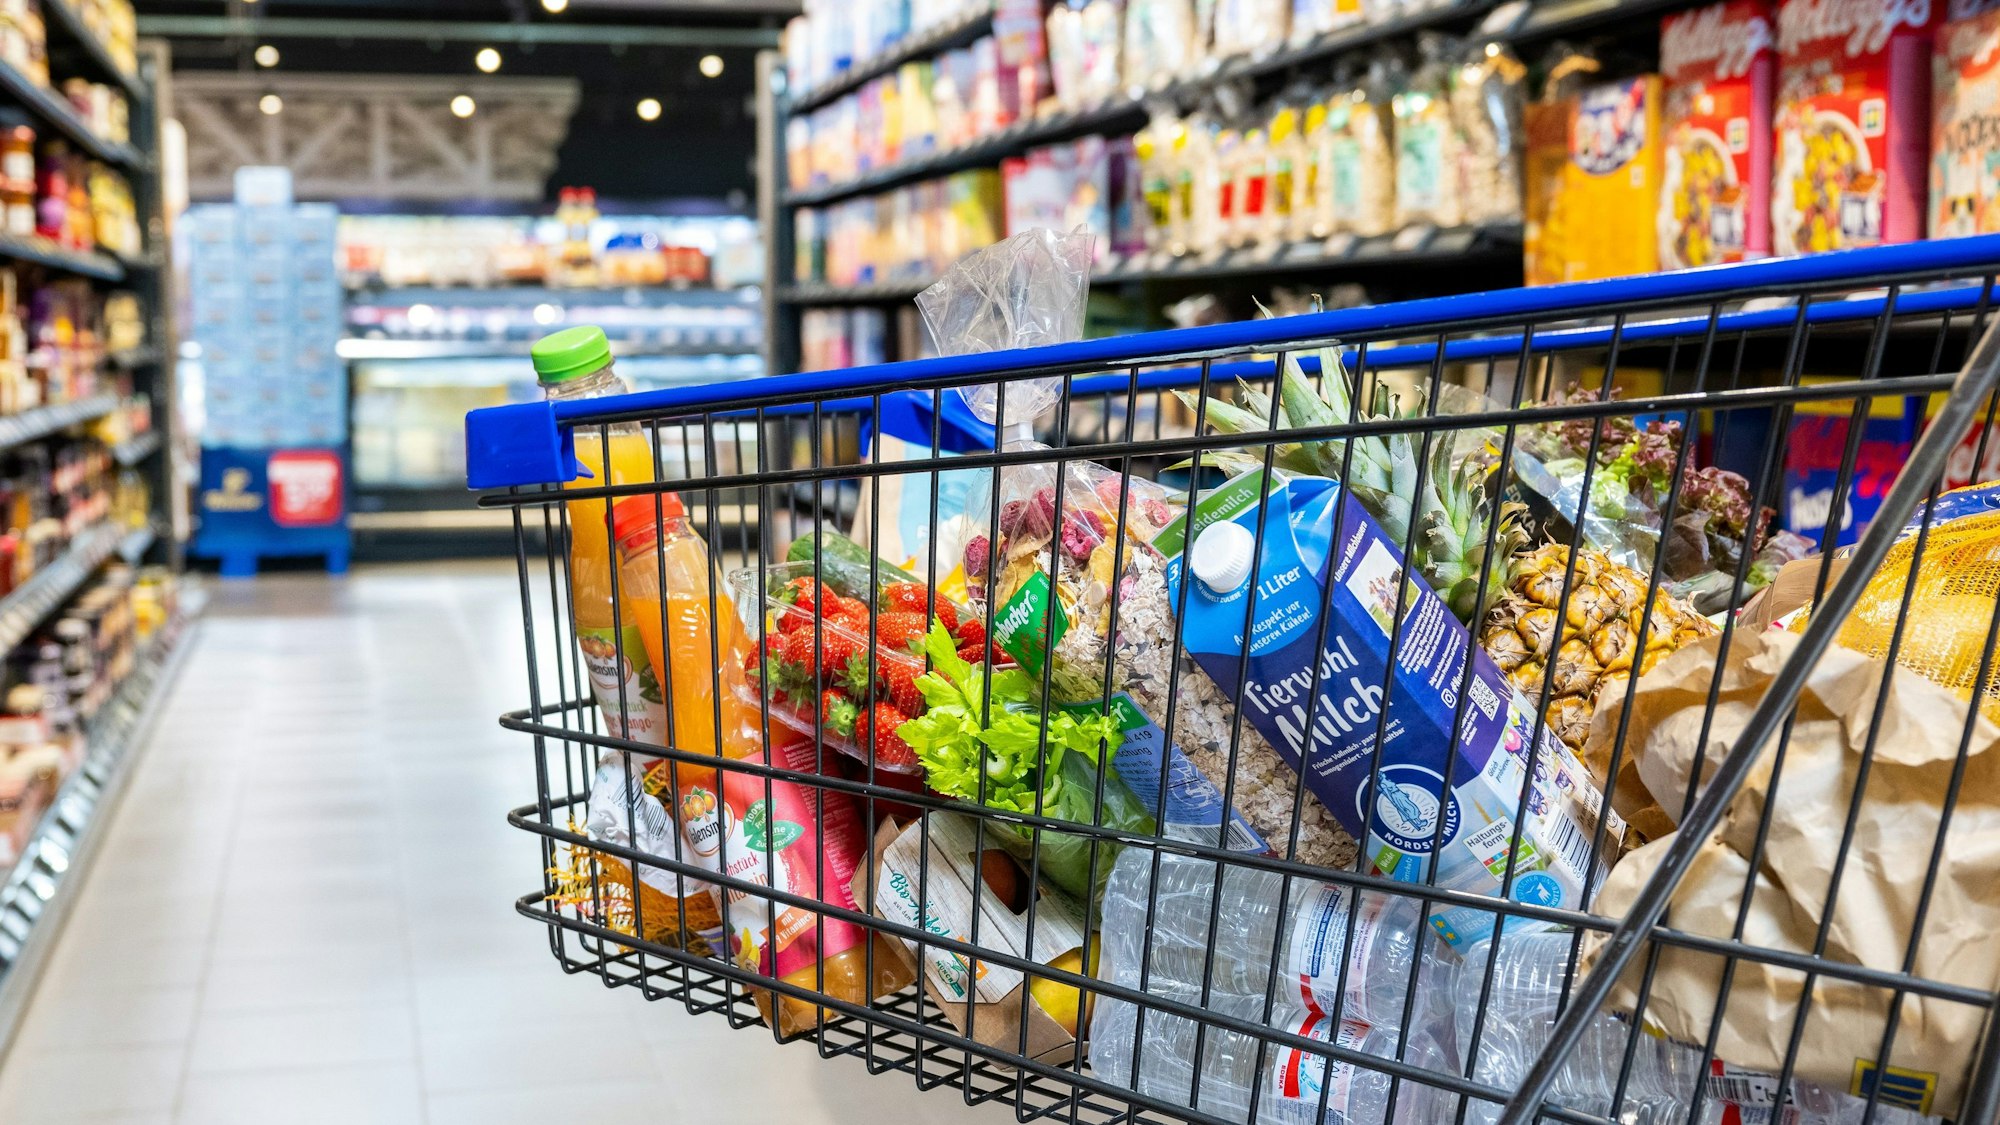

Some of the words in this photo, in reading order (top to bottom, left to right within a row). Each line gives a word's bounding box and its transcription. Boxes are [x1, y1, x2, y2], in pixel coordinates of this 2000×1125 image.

[1505, 483, 1537, 534] EDKA
[1256, 586, 1271, 601] 1
[1270, 566, 1302, 594] Liter
[1286, 600, 1301, 615] vor
[1249, 629, 1281, 653] unseren
[1280, 606, 1313, 633] Kühen!
[587, 661, 620, 677] alensin
[1244, 635, 1360, 715] Tierwohl
[602, 699, 648, 713] Frühtück
[1274, 676, 1394, 758] Milch
[1133, 729, 1152, 742] 419
[1312, 756, 1334, 771] Frische
[1332, 742, 1360, 762] Vollmilch
[1361, 718, 1402, 747] pastesiert
[1117, 745, 1152, 758] schung
[1318, 753, 1362, 778] homogenisiert
[1487, 760, 1500, 778] Gleich
[745, 802, 765, 823] 100%
[755, 813, 767, 830] Fruc
[1442, 800, 1458, 837] MILCH
[688, 820, 727, 846] Valensin
[762, 826, 787, 838] one
[1466, 820, 1508, 848] Haltungs-
[1482, 832, 1505, 850] form
[716, 851, 760, 877] Fhstück
[1496, 851, 1526, 871] Preum
[889, 871, 911, 902] Bio
[781, 912, 795, 927] mit
[892, 900, 903, 912] aus
[900, 909, 913, 922] dem
[1459, 911, 1496, 934] TIERSC
[1331, 1025, 1356, 1080] MINRAL
[1278, 1064, 1287, 1090] EDEKA
